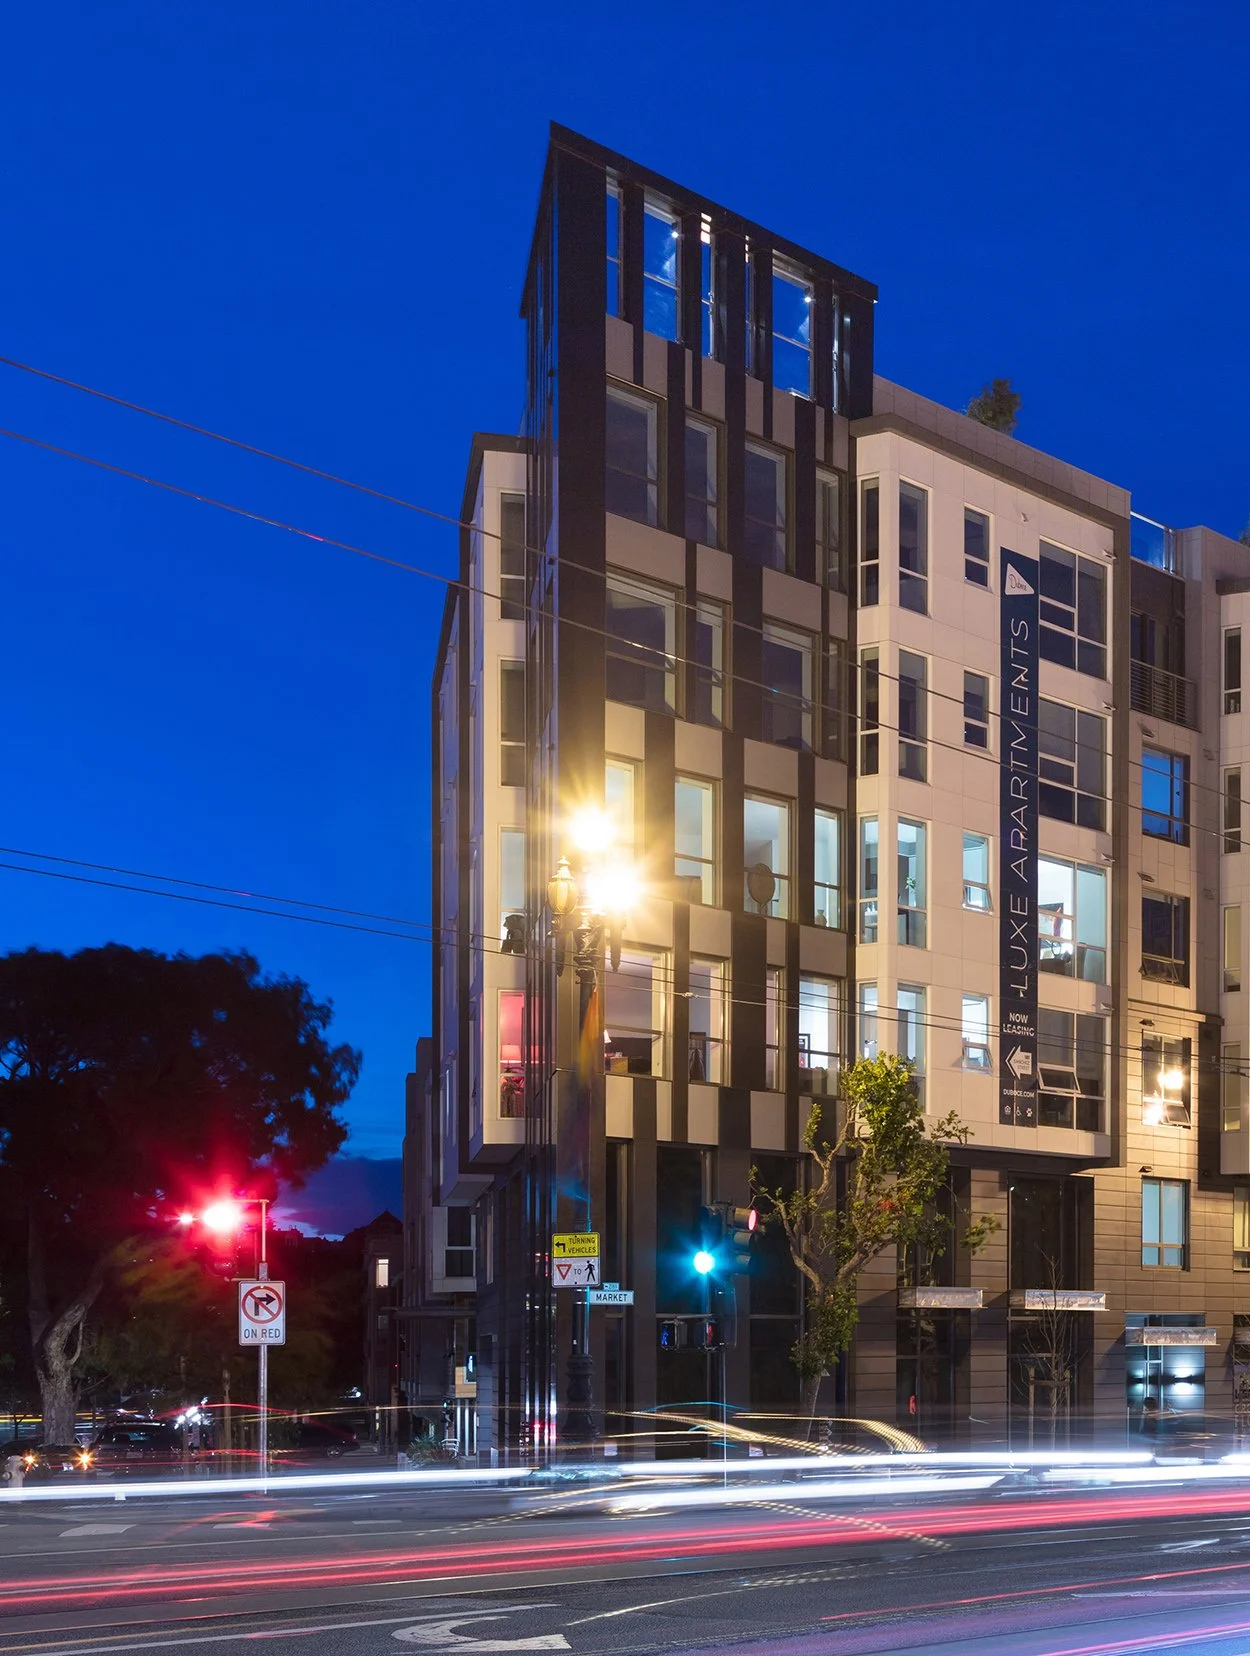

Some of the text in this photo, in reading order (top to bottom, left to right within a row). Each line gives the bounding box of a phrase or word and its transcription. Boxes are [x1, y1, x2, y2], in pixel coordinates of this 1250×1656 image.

[1010, 618, 1029, 991] LUXE APARTMENTS
[1009, 1012, 1029, 1024] NOW
[1002, 1023, 1035, 1037] LEASING
[1003, 1088, 1035, 1098] DUBOCE.COM
[568, 1237, 596, 1245] TURNING
[567, 1246, 597, 1254] VEHICLES
[595, 1293, 628, 1302] MARKET
[243, 1328, 281, 1339] ON RED
